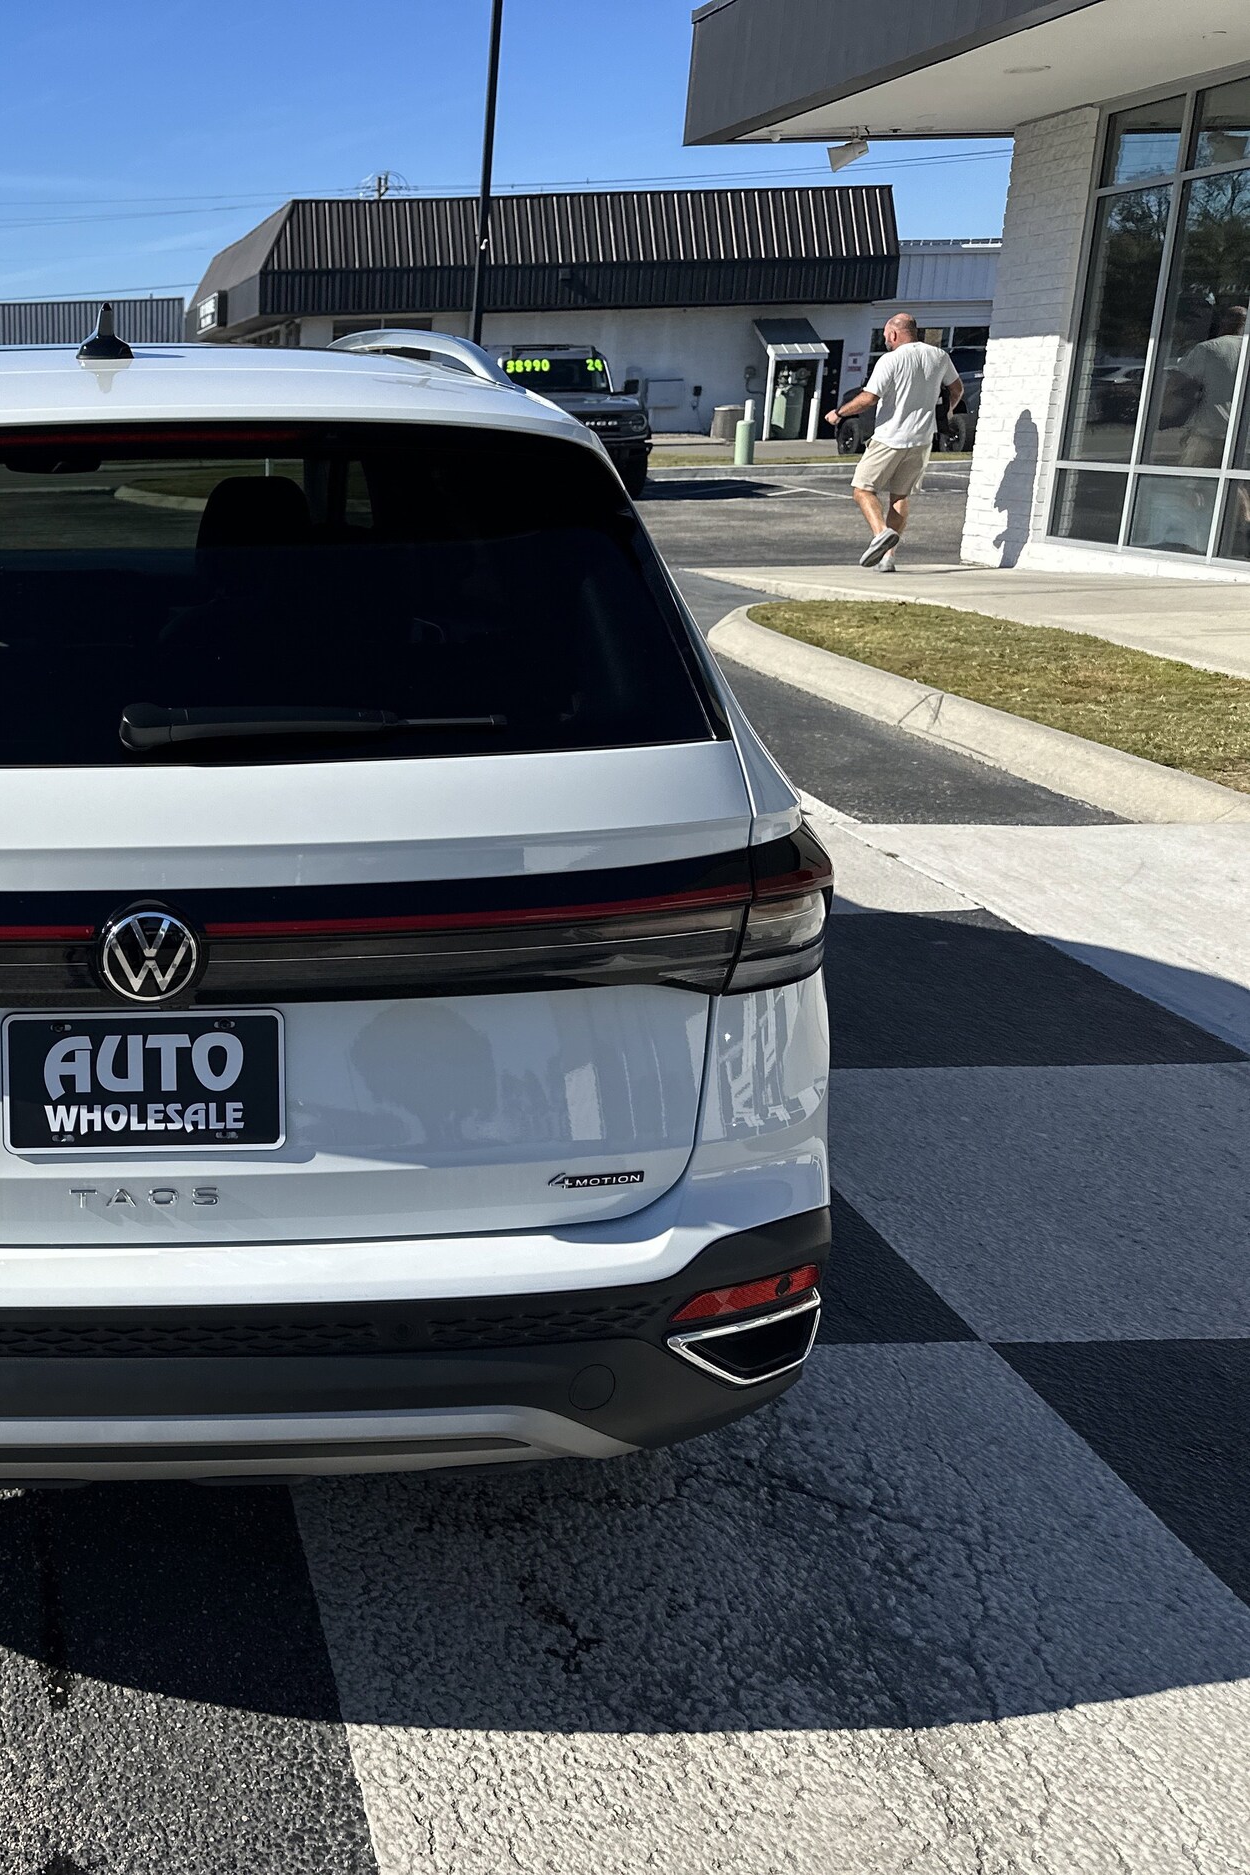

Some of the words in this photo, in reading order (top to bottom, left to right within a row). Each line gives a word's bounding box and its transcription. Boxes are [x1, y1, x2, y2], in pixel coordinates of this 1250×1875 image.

[506, 359, 550, 373] 38990
[586, 359, 603, 372] 24
[44, 1032, 244, 1101] AUTO
[44, 1102, 245, 1135] WHOLESALE
[548, 1172, 641, 1190] 4MOTION
[69, 1187, 219, 1208] TAOS
